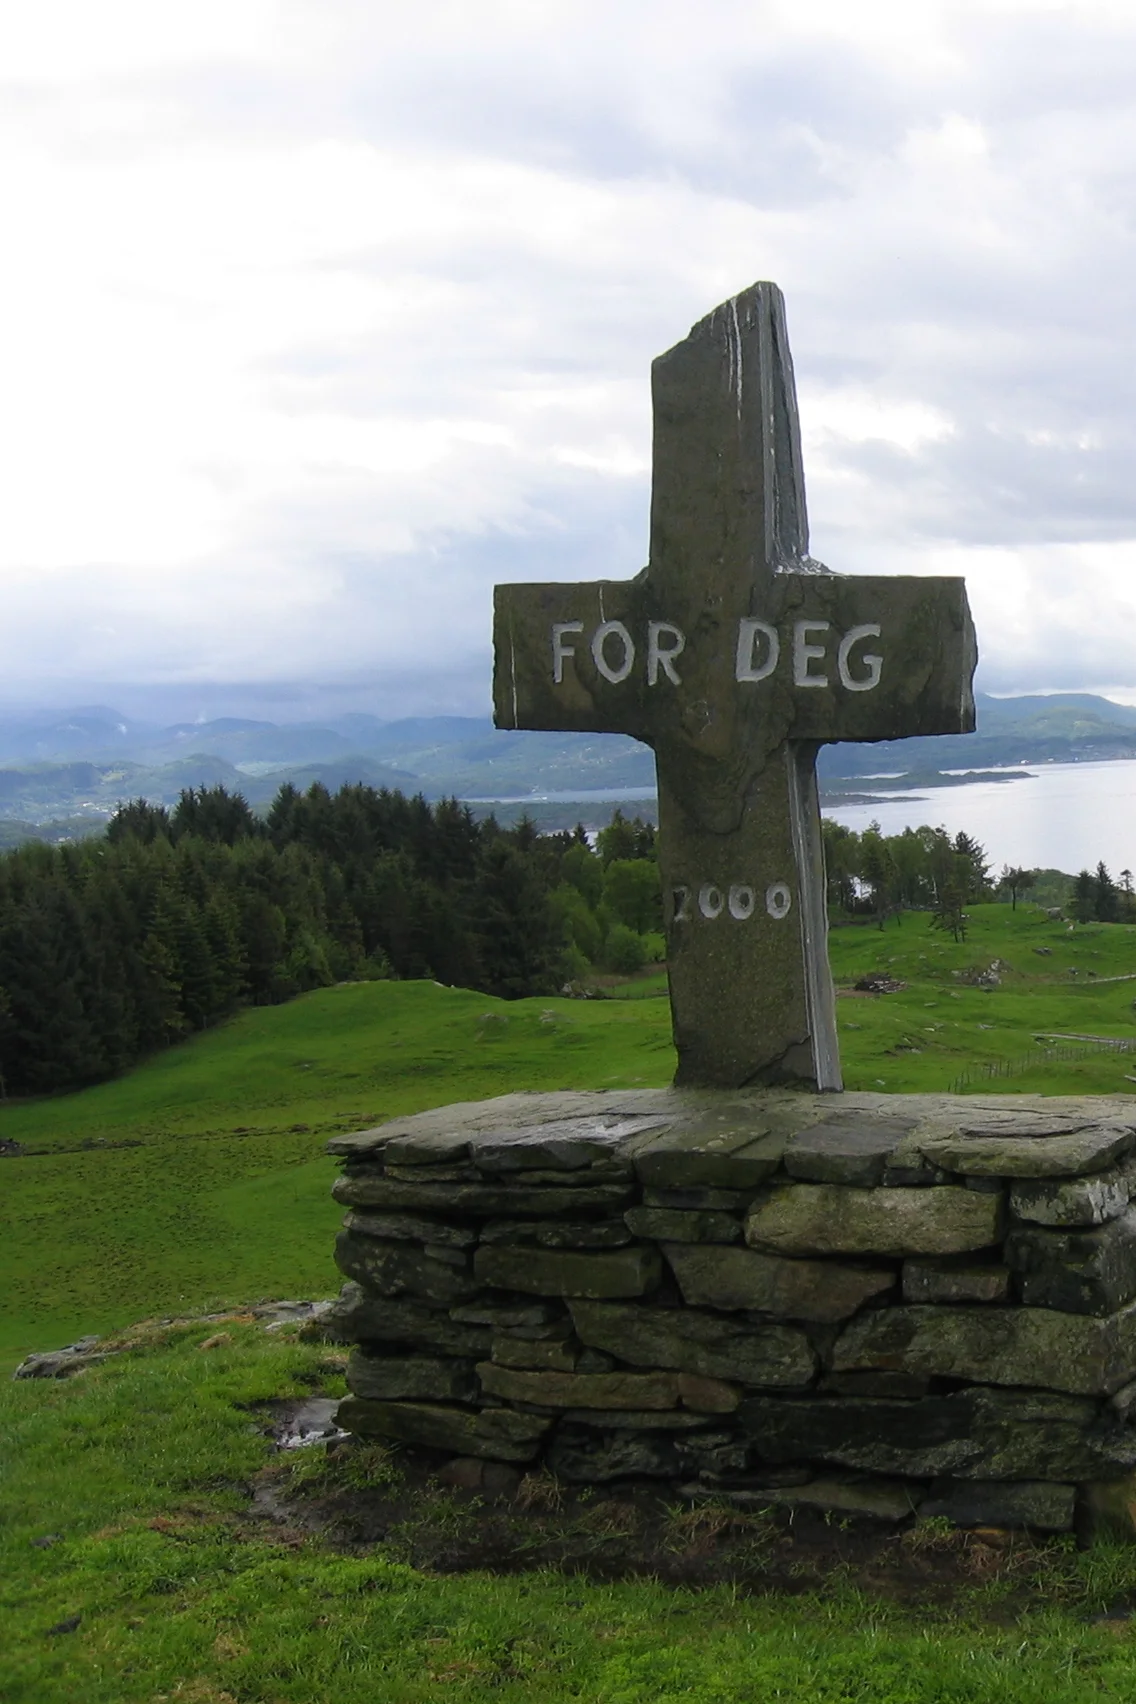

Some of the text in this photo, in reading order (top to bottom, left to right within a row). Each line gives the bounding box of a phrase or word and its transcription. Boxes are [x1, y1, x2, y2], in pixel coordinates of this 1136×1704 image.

[551, 617, 884, 691] FOR DEG
[671, 881, 792, 922] 2000
